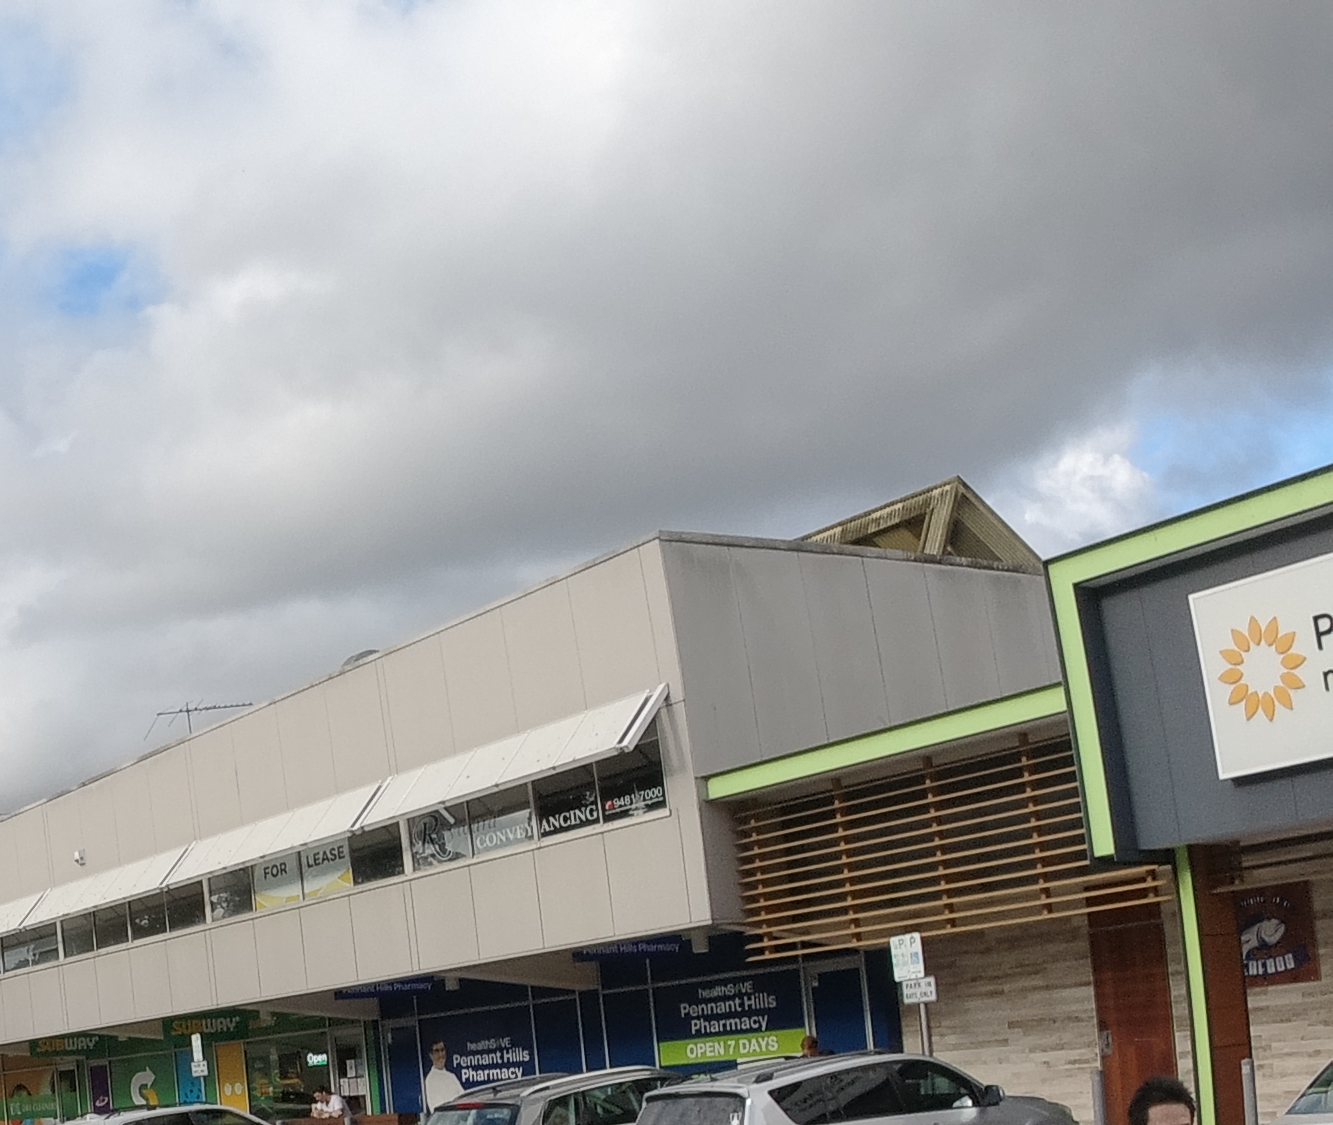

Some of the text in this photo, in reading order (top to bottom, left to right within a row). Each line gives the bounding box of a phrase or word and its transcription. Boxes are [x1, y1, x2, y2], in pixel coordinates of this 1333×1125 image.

[613, 793, 635, 808] 9481
[639, 786, 662, 801] 7000
[263, 845, 346, 880] FOR LEASE
[619, 943, 637, 952] Hills
[639, 942, 679, 952] Pharmacy
[376, 982, 393, 991] Hills
[393, 980, 432, 992] Pharmacy
[680, 993, 776, 1018] Pennant Hills
[171, 1016, 239, 1035] SUBWAY
[691, 1015, 768, 1035] Pharmacy
[38, 1036, 99, 1051] SUBWAY
[686, 1036, 779, 1058] OPEN 7 DAYS
[307, 1053, 327, 1064] Open
[453, 1048, 530, 1067] Pennant Hills
[461, 1066, 523, 1083] Pharmacy
